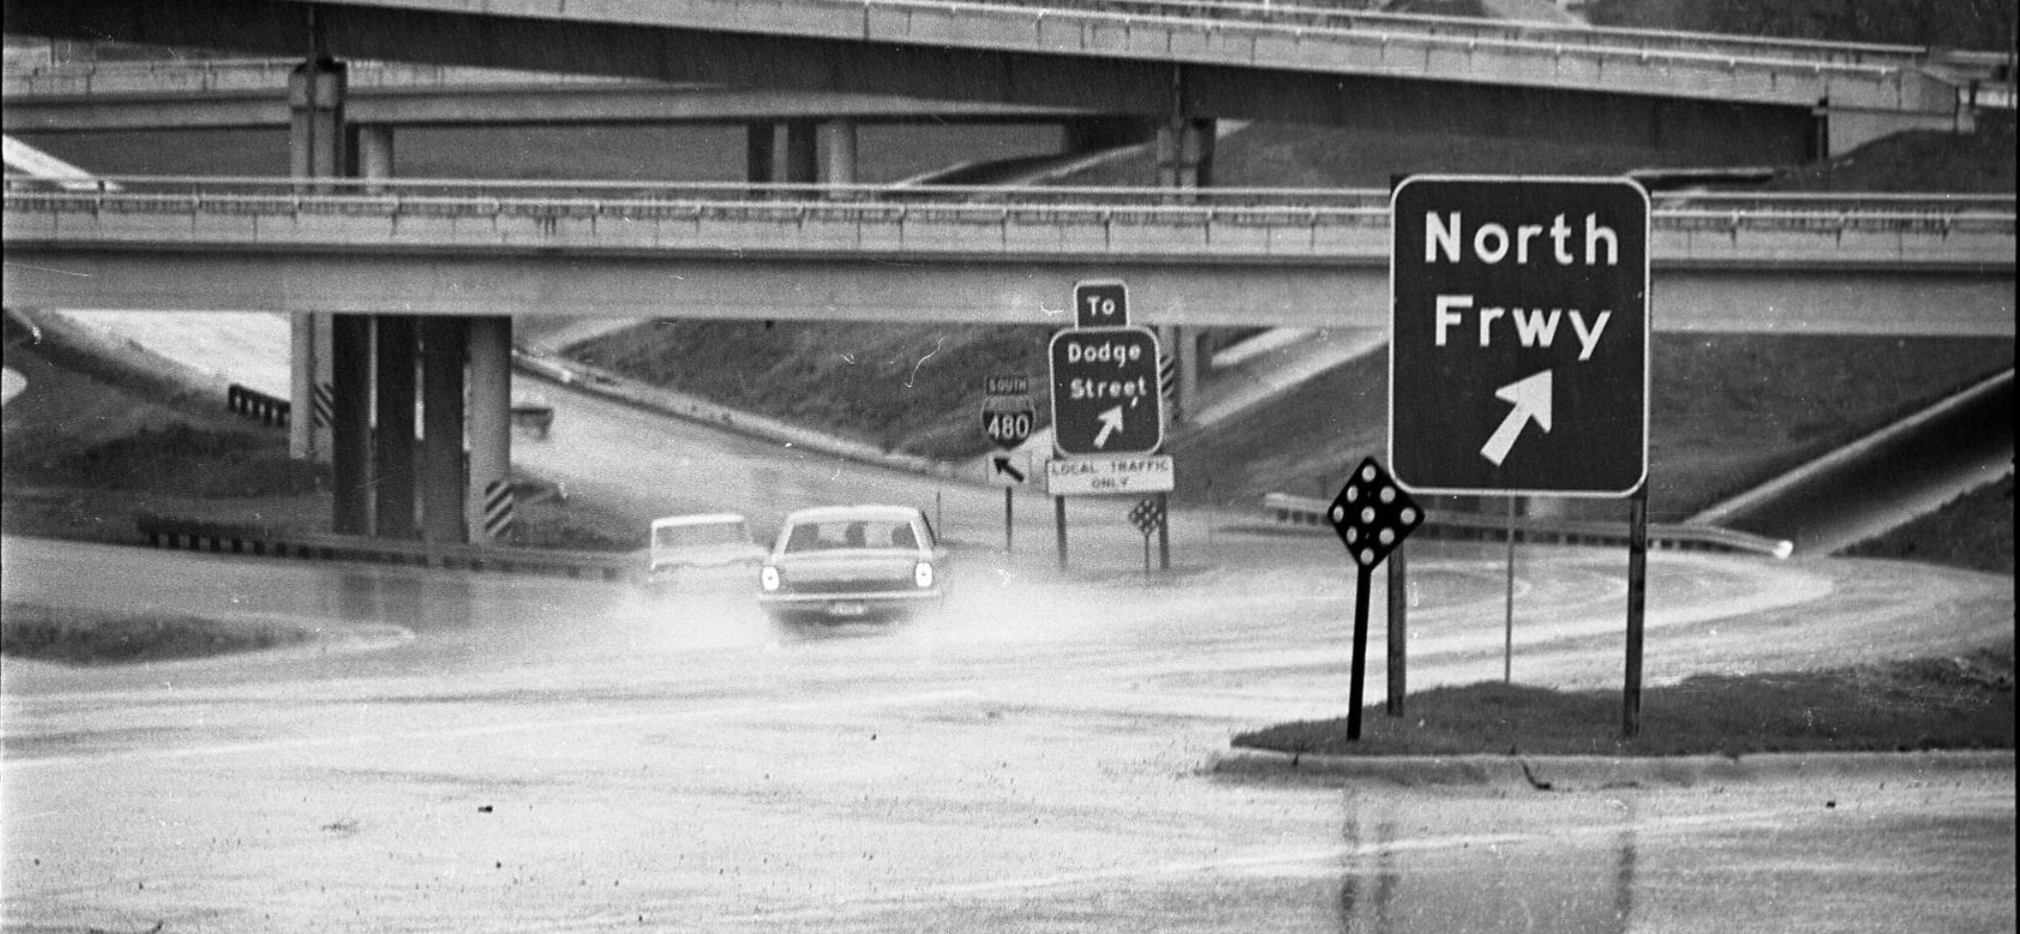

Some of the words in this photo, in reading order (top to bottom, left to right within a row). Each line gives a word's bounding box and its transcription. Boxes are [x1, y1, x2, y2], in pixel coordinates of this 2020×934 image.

[1425, 211, 1619, 265] North
[1087, 296, 1116, 316] To
[1435, 294, 1612, 361] Frwy
[1068, 342, 1142, 368] Dodge
[989, 378, 1027, 392] SOUTH
[1070, 376, 1147, 399] Street
[988, 414, 1029, 440] 480
[1052, 461, 1095, 475] LOCAL
[1111, 459, 1168, 472] TRAFFIC
[1091, 475, 1130, 488] ONLY
